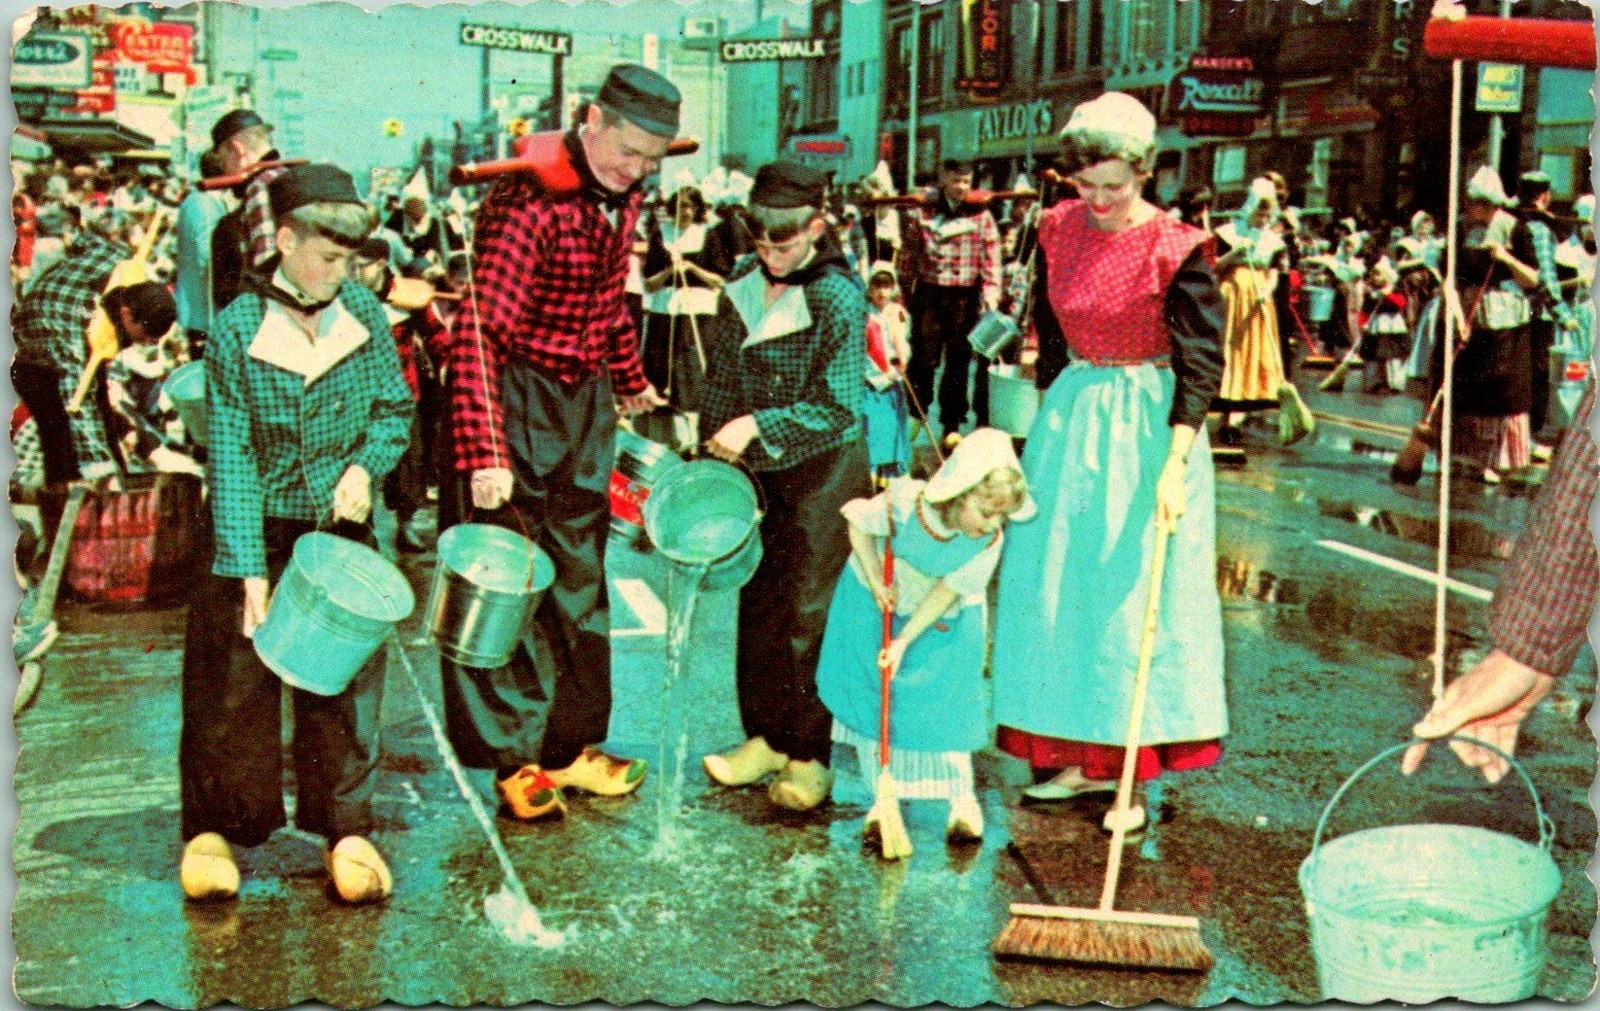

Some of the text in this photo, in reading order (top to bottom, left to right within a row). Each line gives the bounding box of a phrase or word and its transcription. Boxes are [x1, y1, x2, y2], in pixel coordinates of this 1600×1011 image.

[462, 24, 567, 54] CROSSWALK
[723, 40, 825, 60] CROSSWALK
[1178, 76, 1264, 111] Rexall
